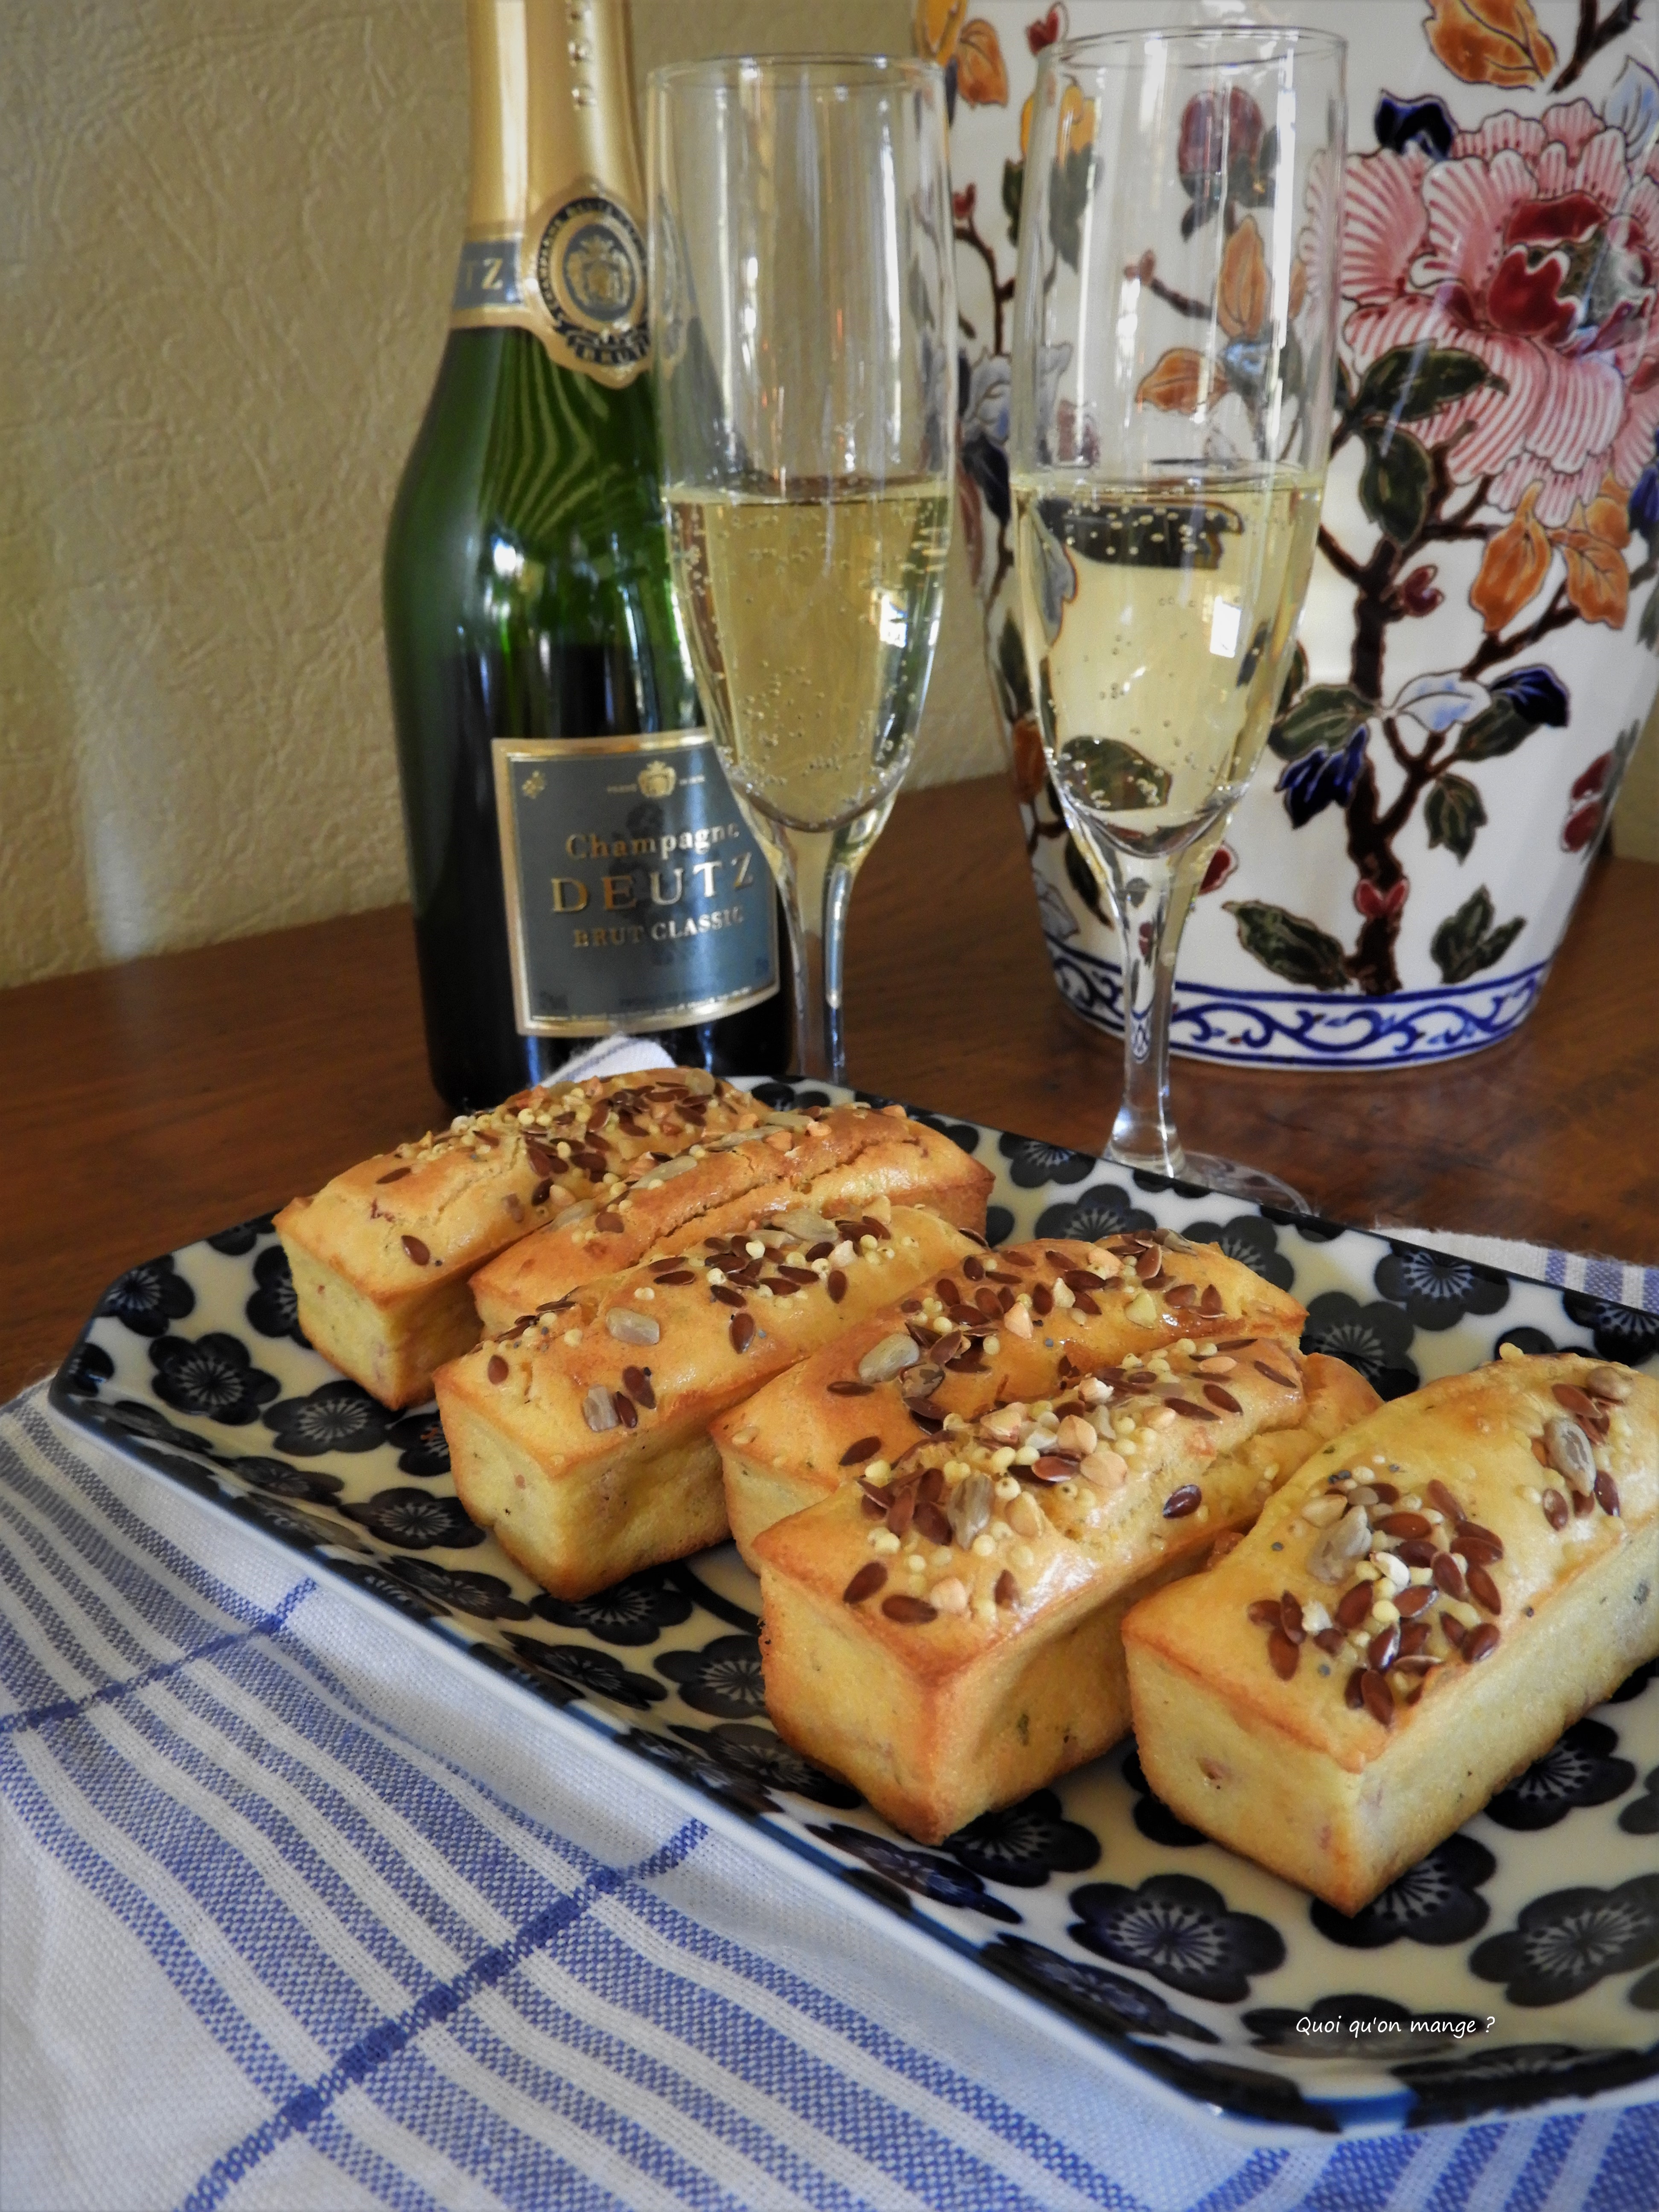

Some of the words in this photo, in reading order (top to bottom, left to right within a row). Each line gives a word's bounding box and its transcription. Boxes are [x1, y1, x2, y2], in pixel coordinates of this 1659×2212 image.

[565, 823, 740, 861] Champagne
[551, 852, 754, 912] DEUTZ
[573, 925, 644, 947] BRUT
[651, 906, 744, 940] CLASSIC
